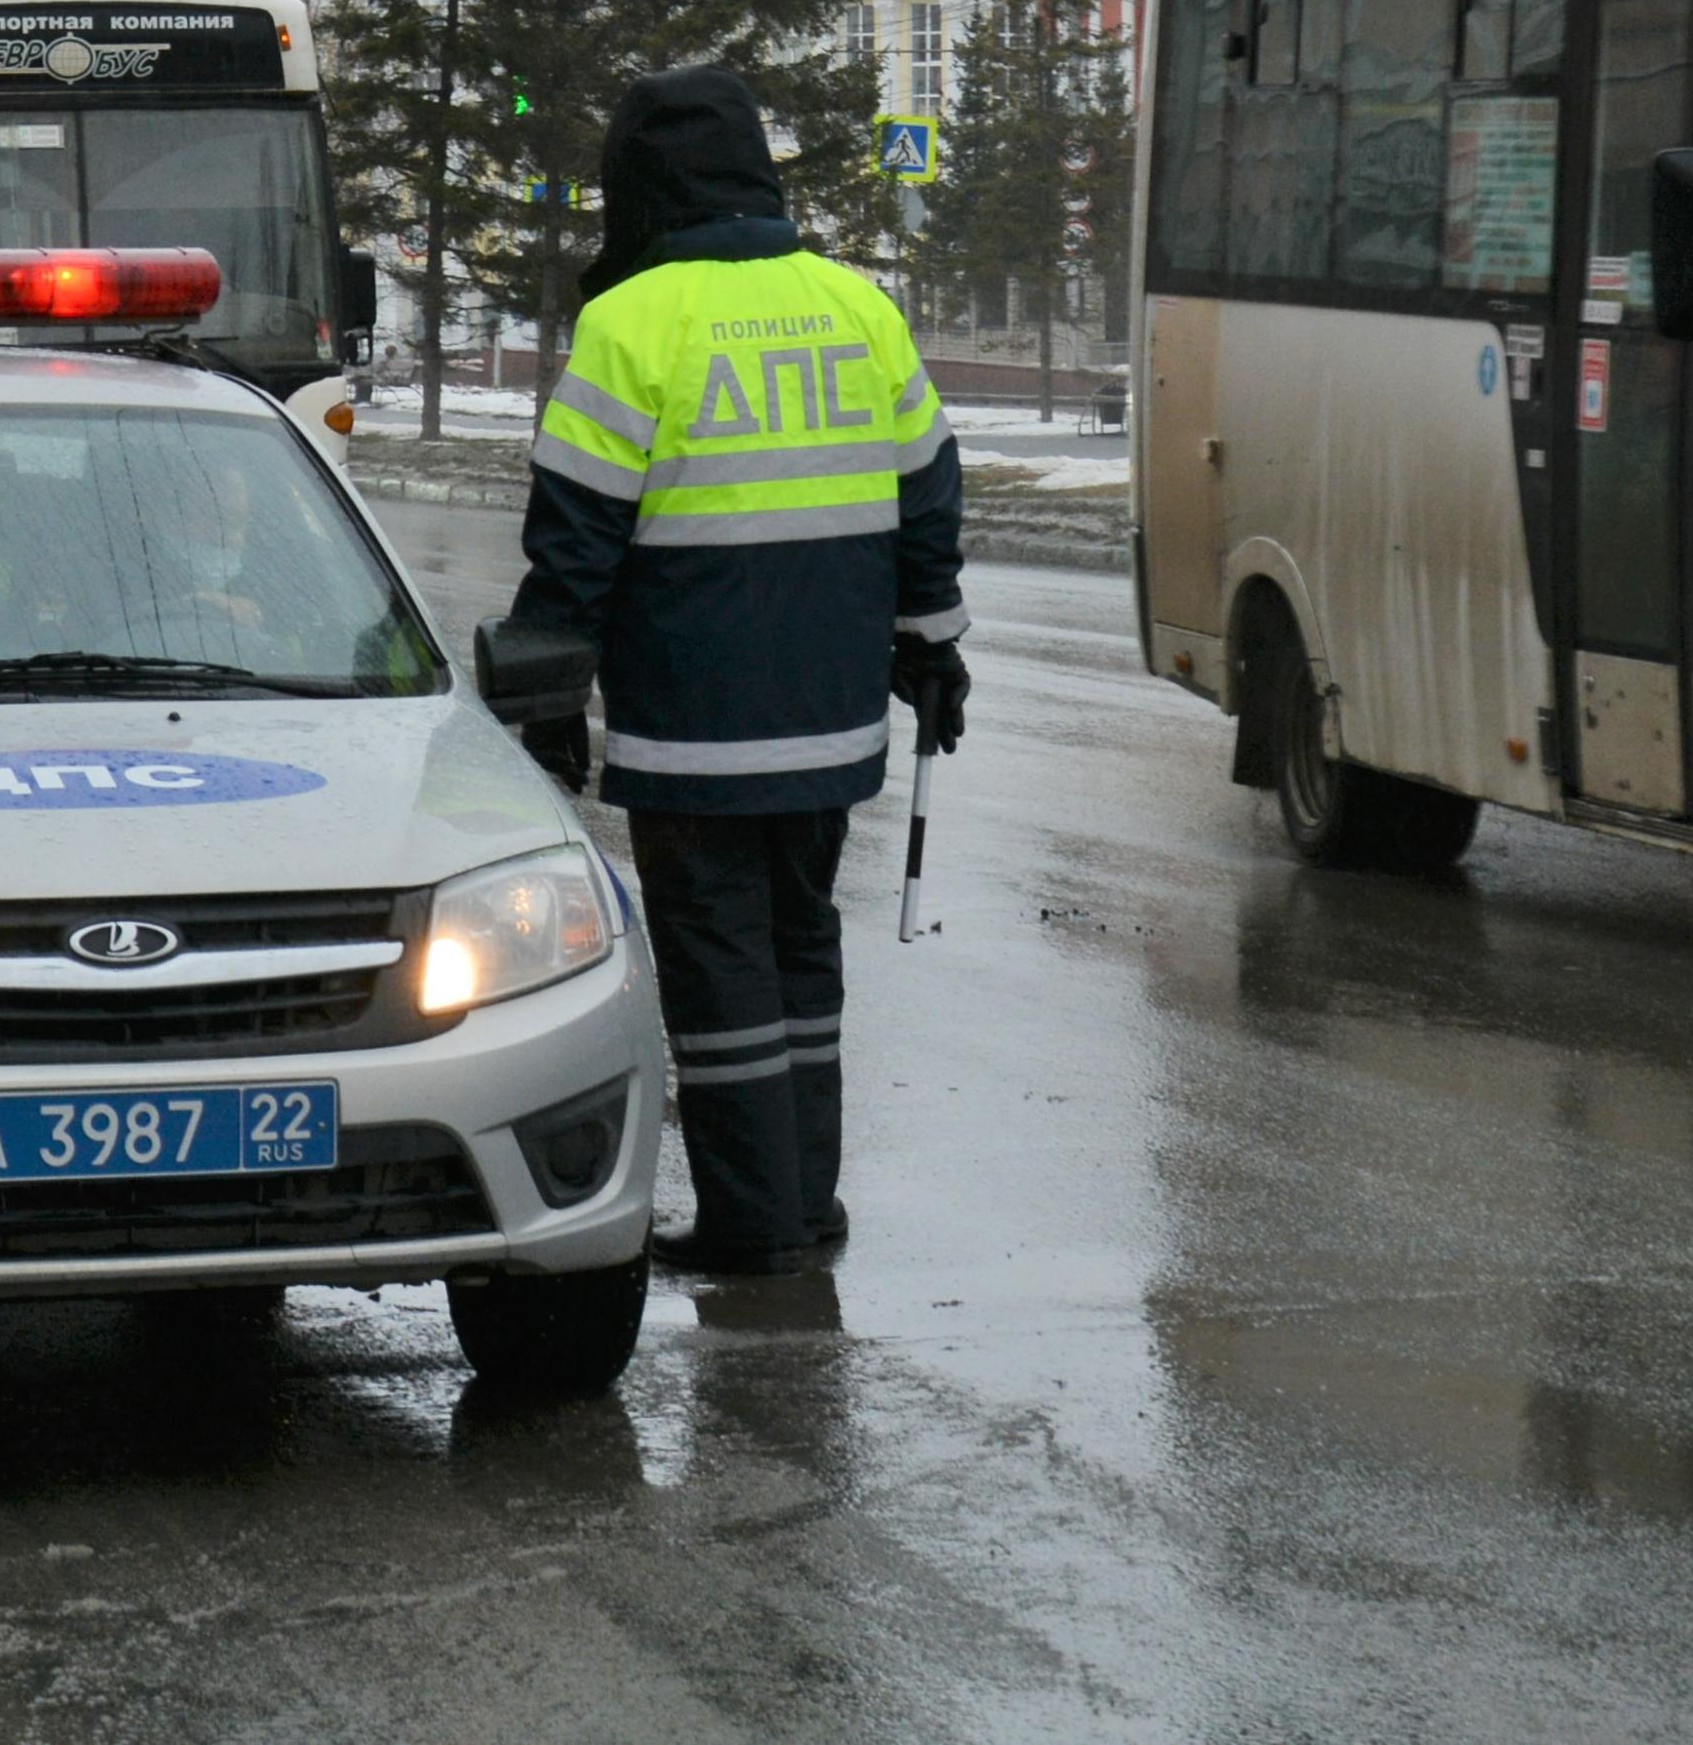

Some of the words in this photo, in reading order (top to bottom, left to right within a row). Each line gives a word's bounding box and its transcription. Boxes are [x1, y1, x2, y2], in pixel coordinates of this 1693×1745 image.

[110, 15, 234, 30] компания
[711, 314, 834, 342] ПОЛИЦИЯ
[687, 342, 873, 440] ДПС
[39, 1099, 204, 1167] 3987
[251, 1092, 311, 1141] 22
[258, 1143, 303, 1162] RUS
